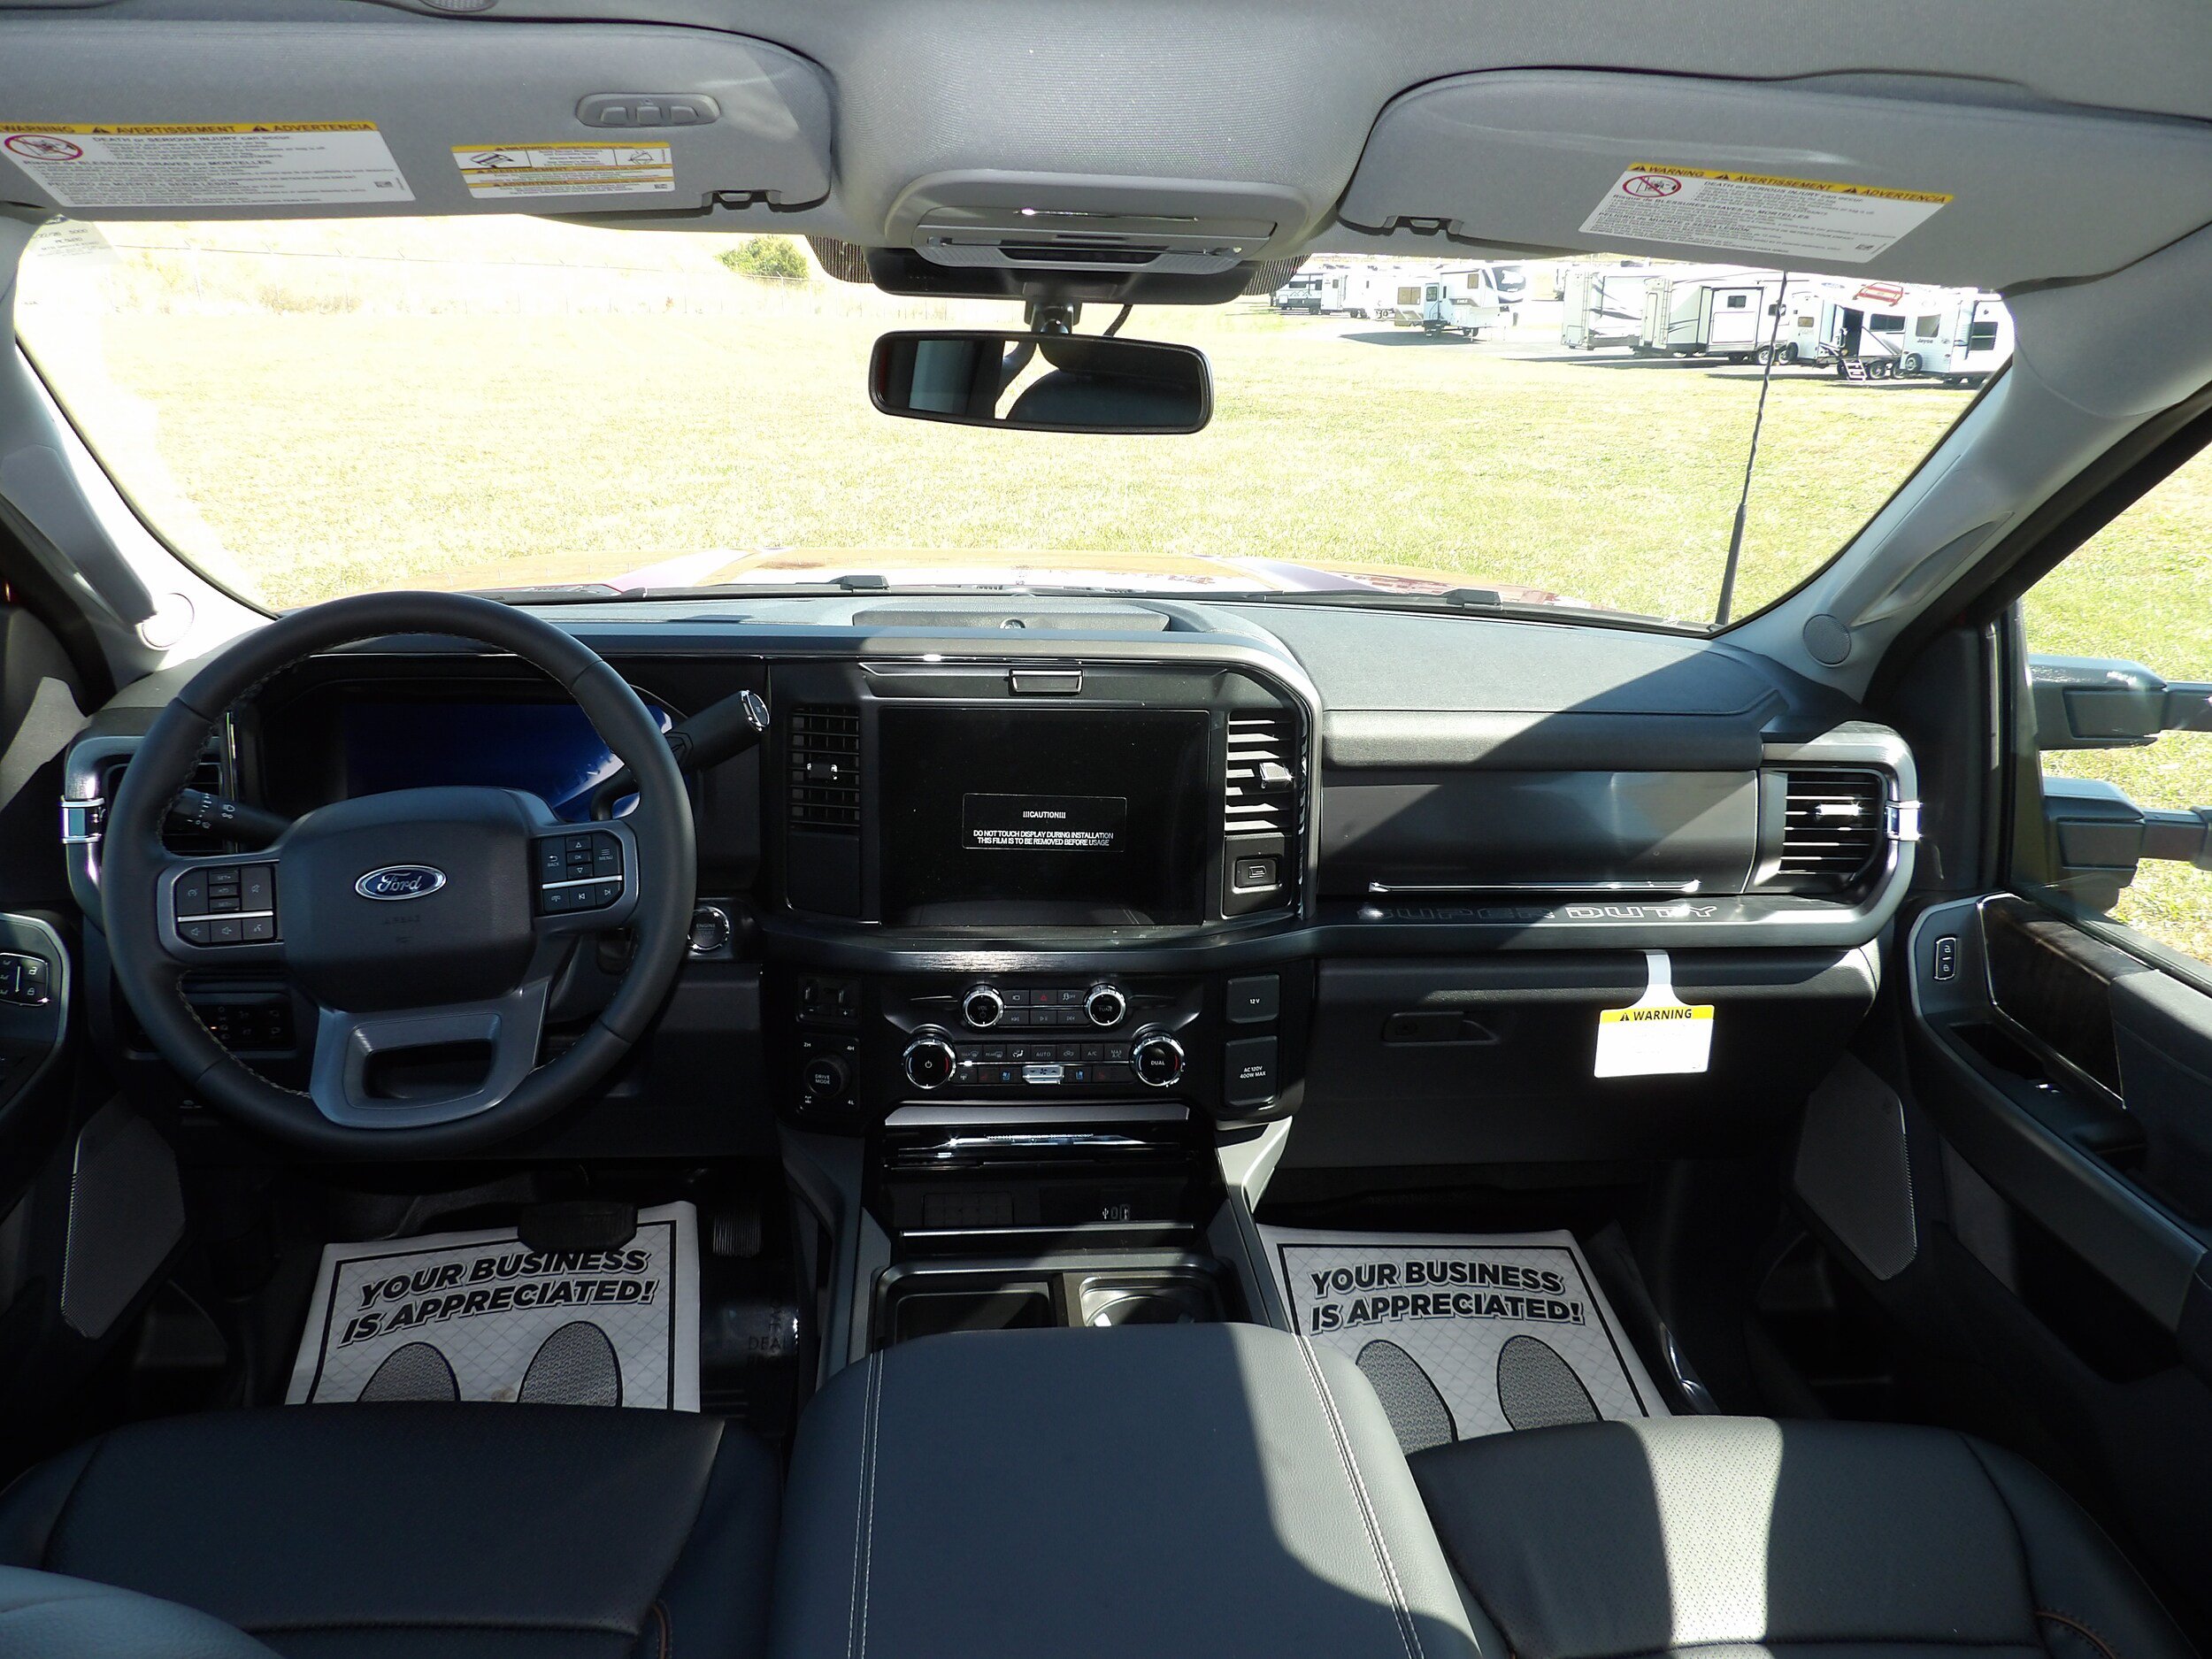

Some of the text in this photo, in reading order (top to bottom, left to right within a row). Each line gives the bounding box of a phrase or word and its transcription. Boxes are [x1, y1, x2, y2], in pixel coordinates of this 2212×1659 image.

[273, 123, 373, 132] ADVERTENCIA
[1647, 166, 1947, 203] WARNING AVERTISSEMENT ADVERTENCIA
[1757, 210, 1809, 219] MORTELLES
[1020, 830, 1046, 839] DISPLAY
[377, 872, 423, 893] Ford
[1356, 904, 1717, 920] SUPER DUTY
[1633, 1009, 1693, 1021] WARNING
[361, 1249, 650, 1308] YOUR BUSINESS
[1311, 1261, 1564, 1297] YOUR BUSINESS
[340, 1279, 657, 1348] IS APPRECIATED!
[1311, 1292, 1582, 1333] IS APPRECIATED!
